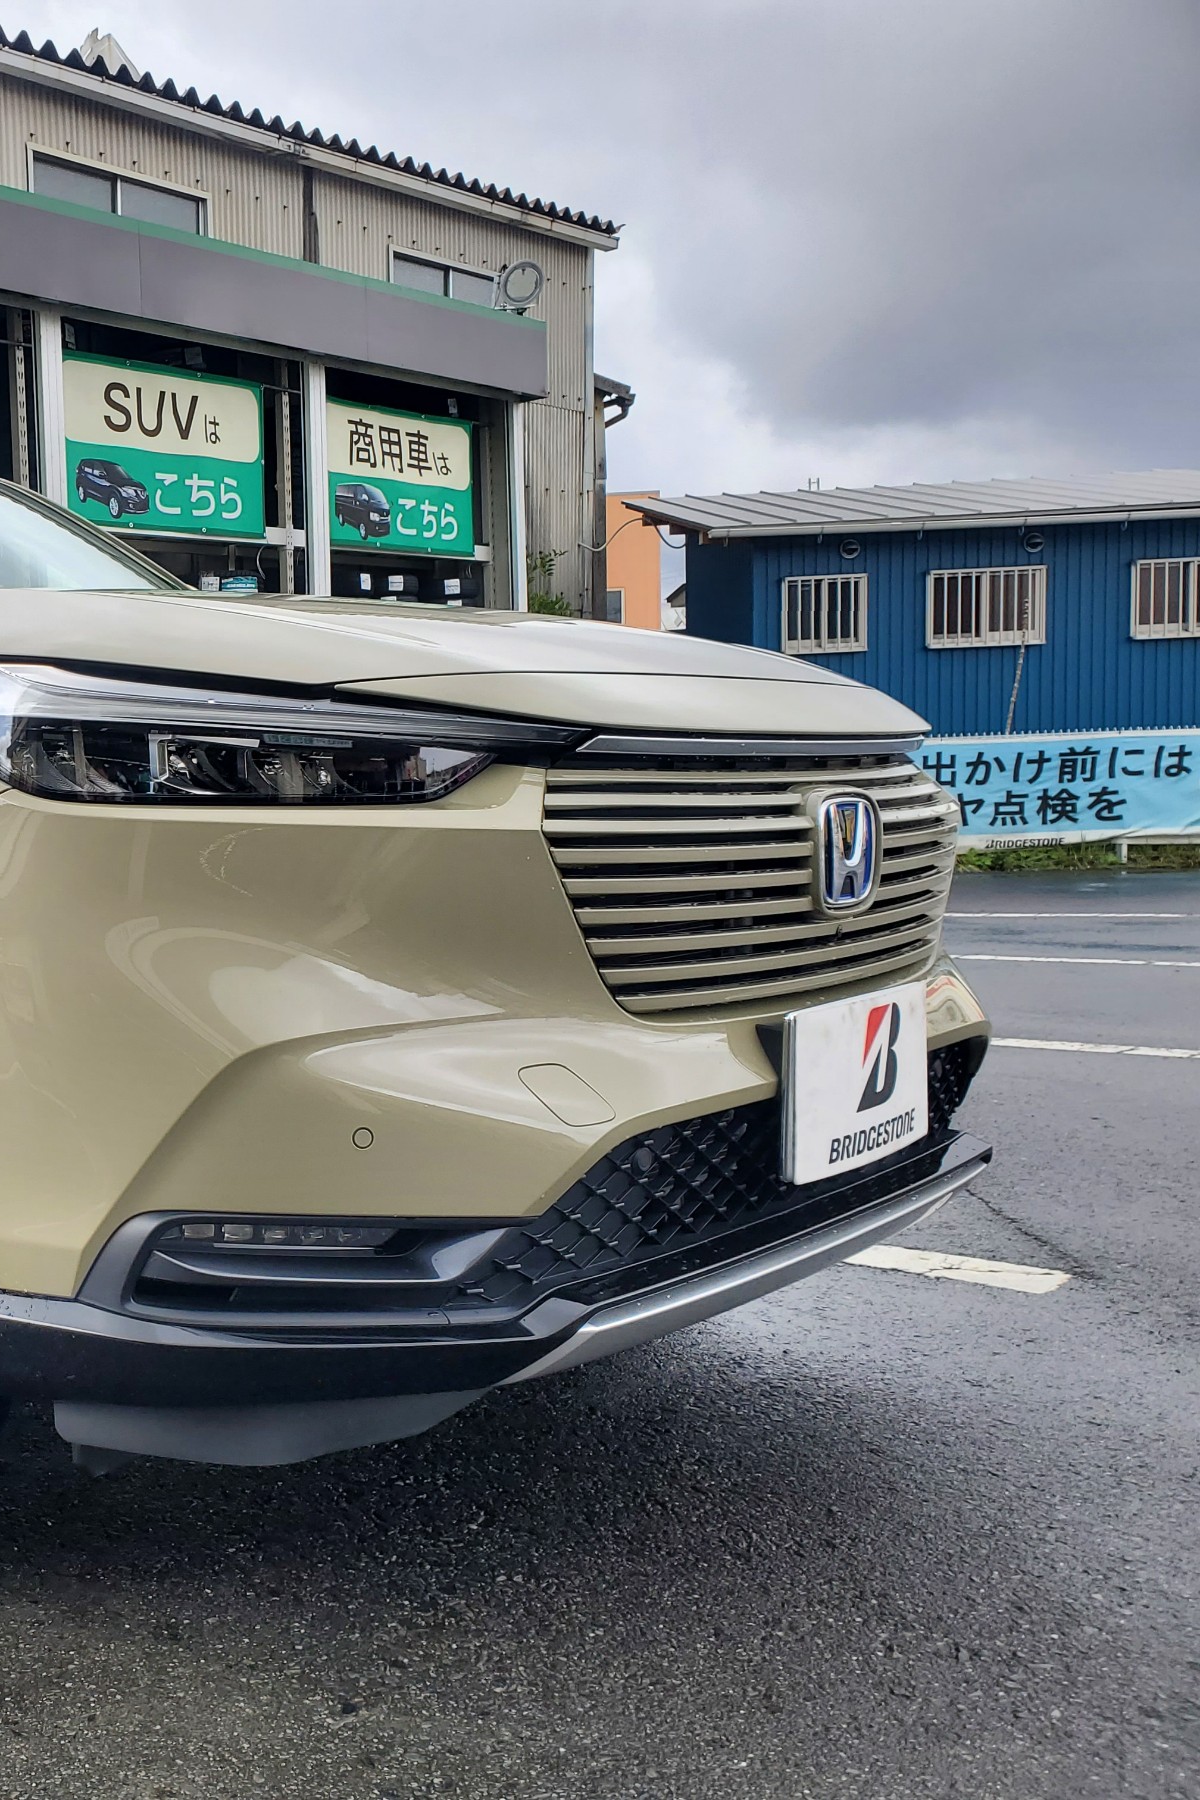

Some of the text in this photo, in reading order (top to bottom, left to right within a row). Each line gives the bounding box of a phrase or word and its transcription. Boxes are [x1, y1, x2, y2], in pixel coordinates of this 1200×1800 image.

[347, 418, 453, 476] 商用車は
[154, 472, 243, 520] こちら
[395, 497, 459, 541] こちら
[922, 744, 1193, 788] 出かけ前には
[985, 837, 1066, 850] BRIDGESTONE
[828, 1107, 916, 1165] BRIDGESTONE
